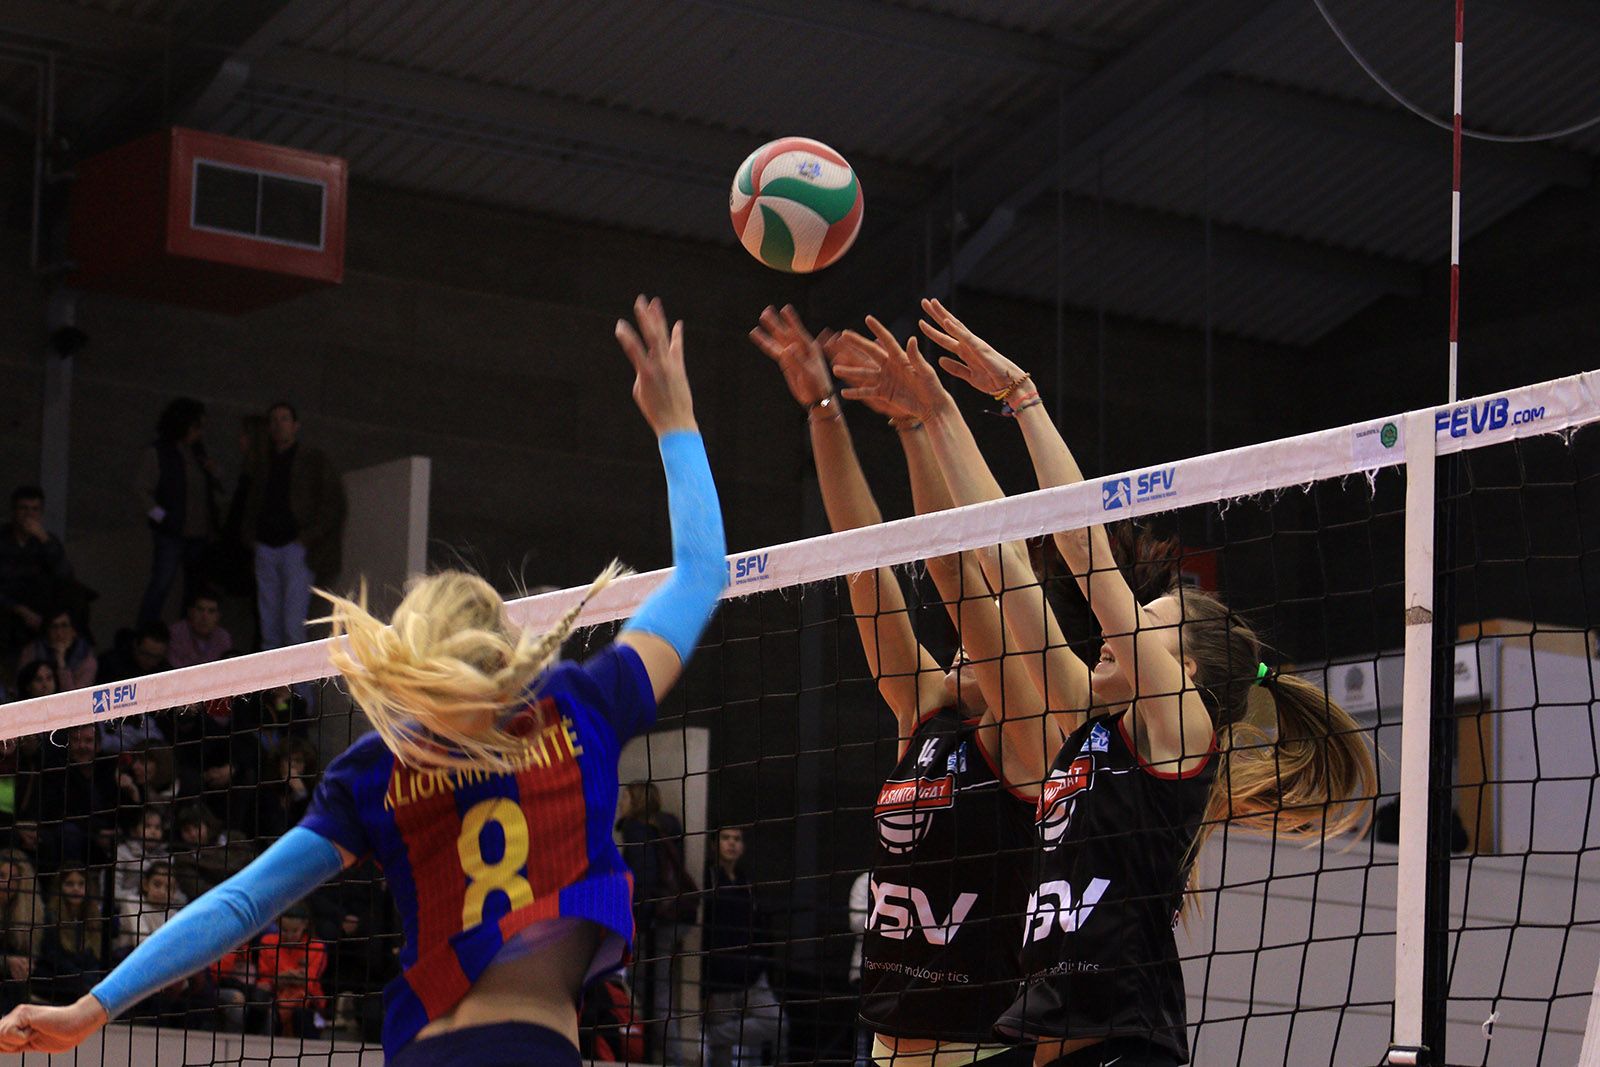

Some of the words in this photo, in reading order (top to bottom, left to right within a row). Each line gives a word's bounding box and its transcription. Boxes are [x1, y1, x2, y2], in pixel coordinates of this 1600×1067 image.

[1137, 467, 1176, 496] SFV
[736, 553, 768, 578] SFV
[113, 683, 137, 703] SFV
[457, 797, 535, 931] 8
[918, 968, 969, 983] Logitics
